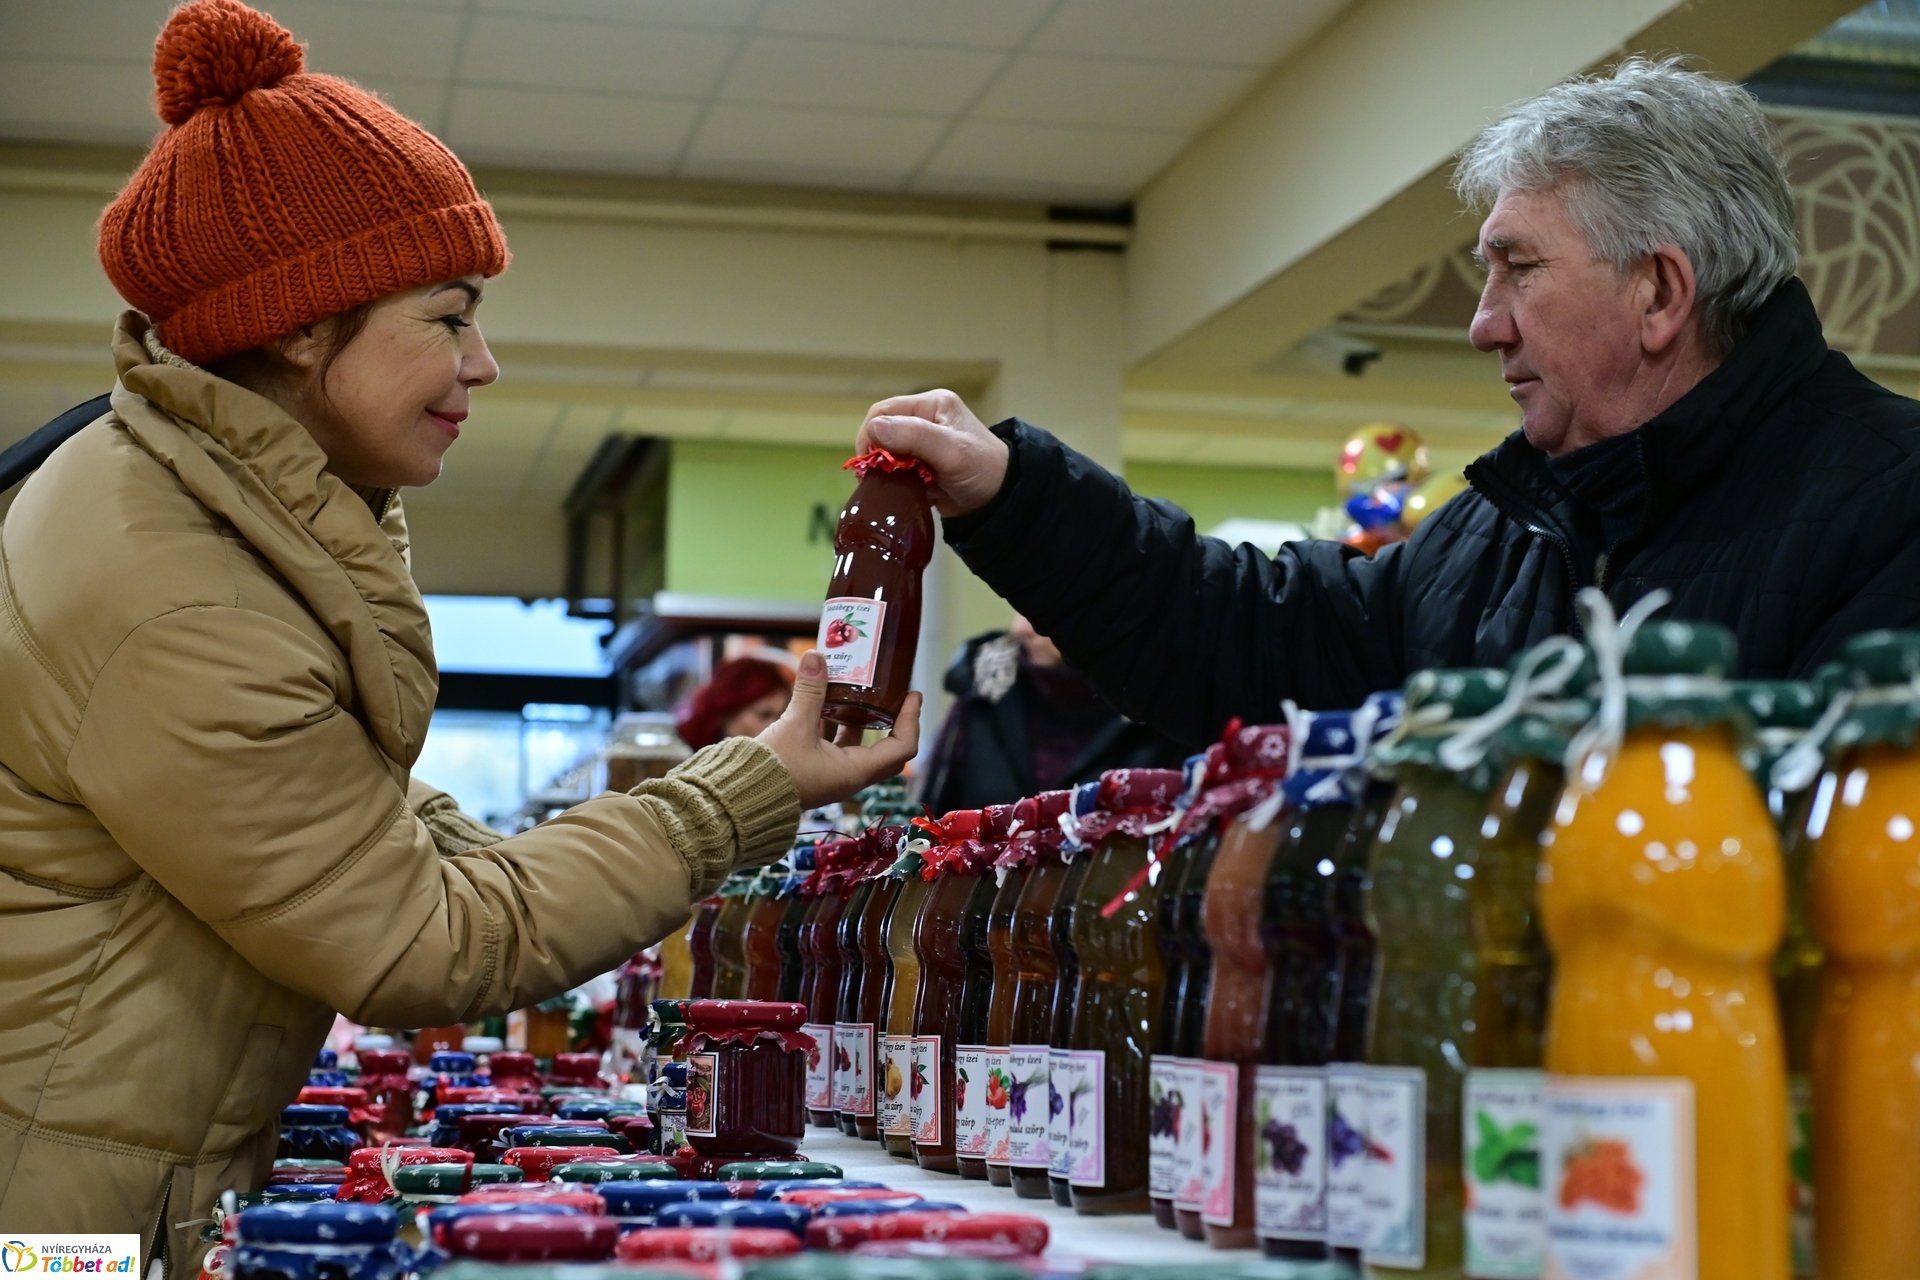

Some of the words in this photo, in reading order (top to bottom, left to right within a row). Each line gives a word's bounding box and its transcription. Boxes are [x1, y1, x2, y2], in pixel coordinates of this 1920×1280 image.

[966, 1053, 978, 1063] ízei
[1027, 1053, 1042, 1064] ízei
[961, 1117, 976, 1130] szörp
[1025, 1123, 1045, 1138] szörp
